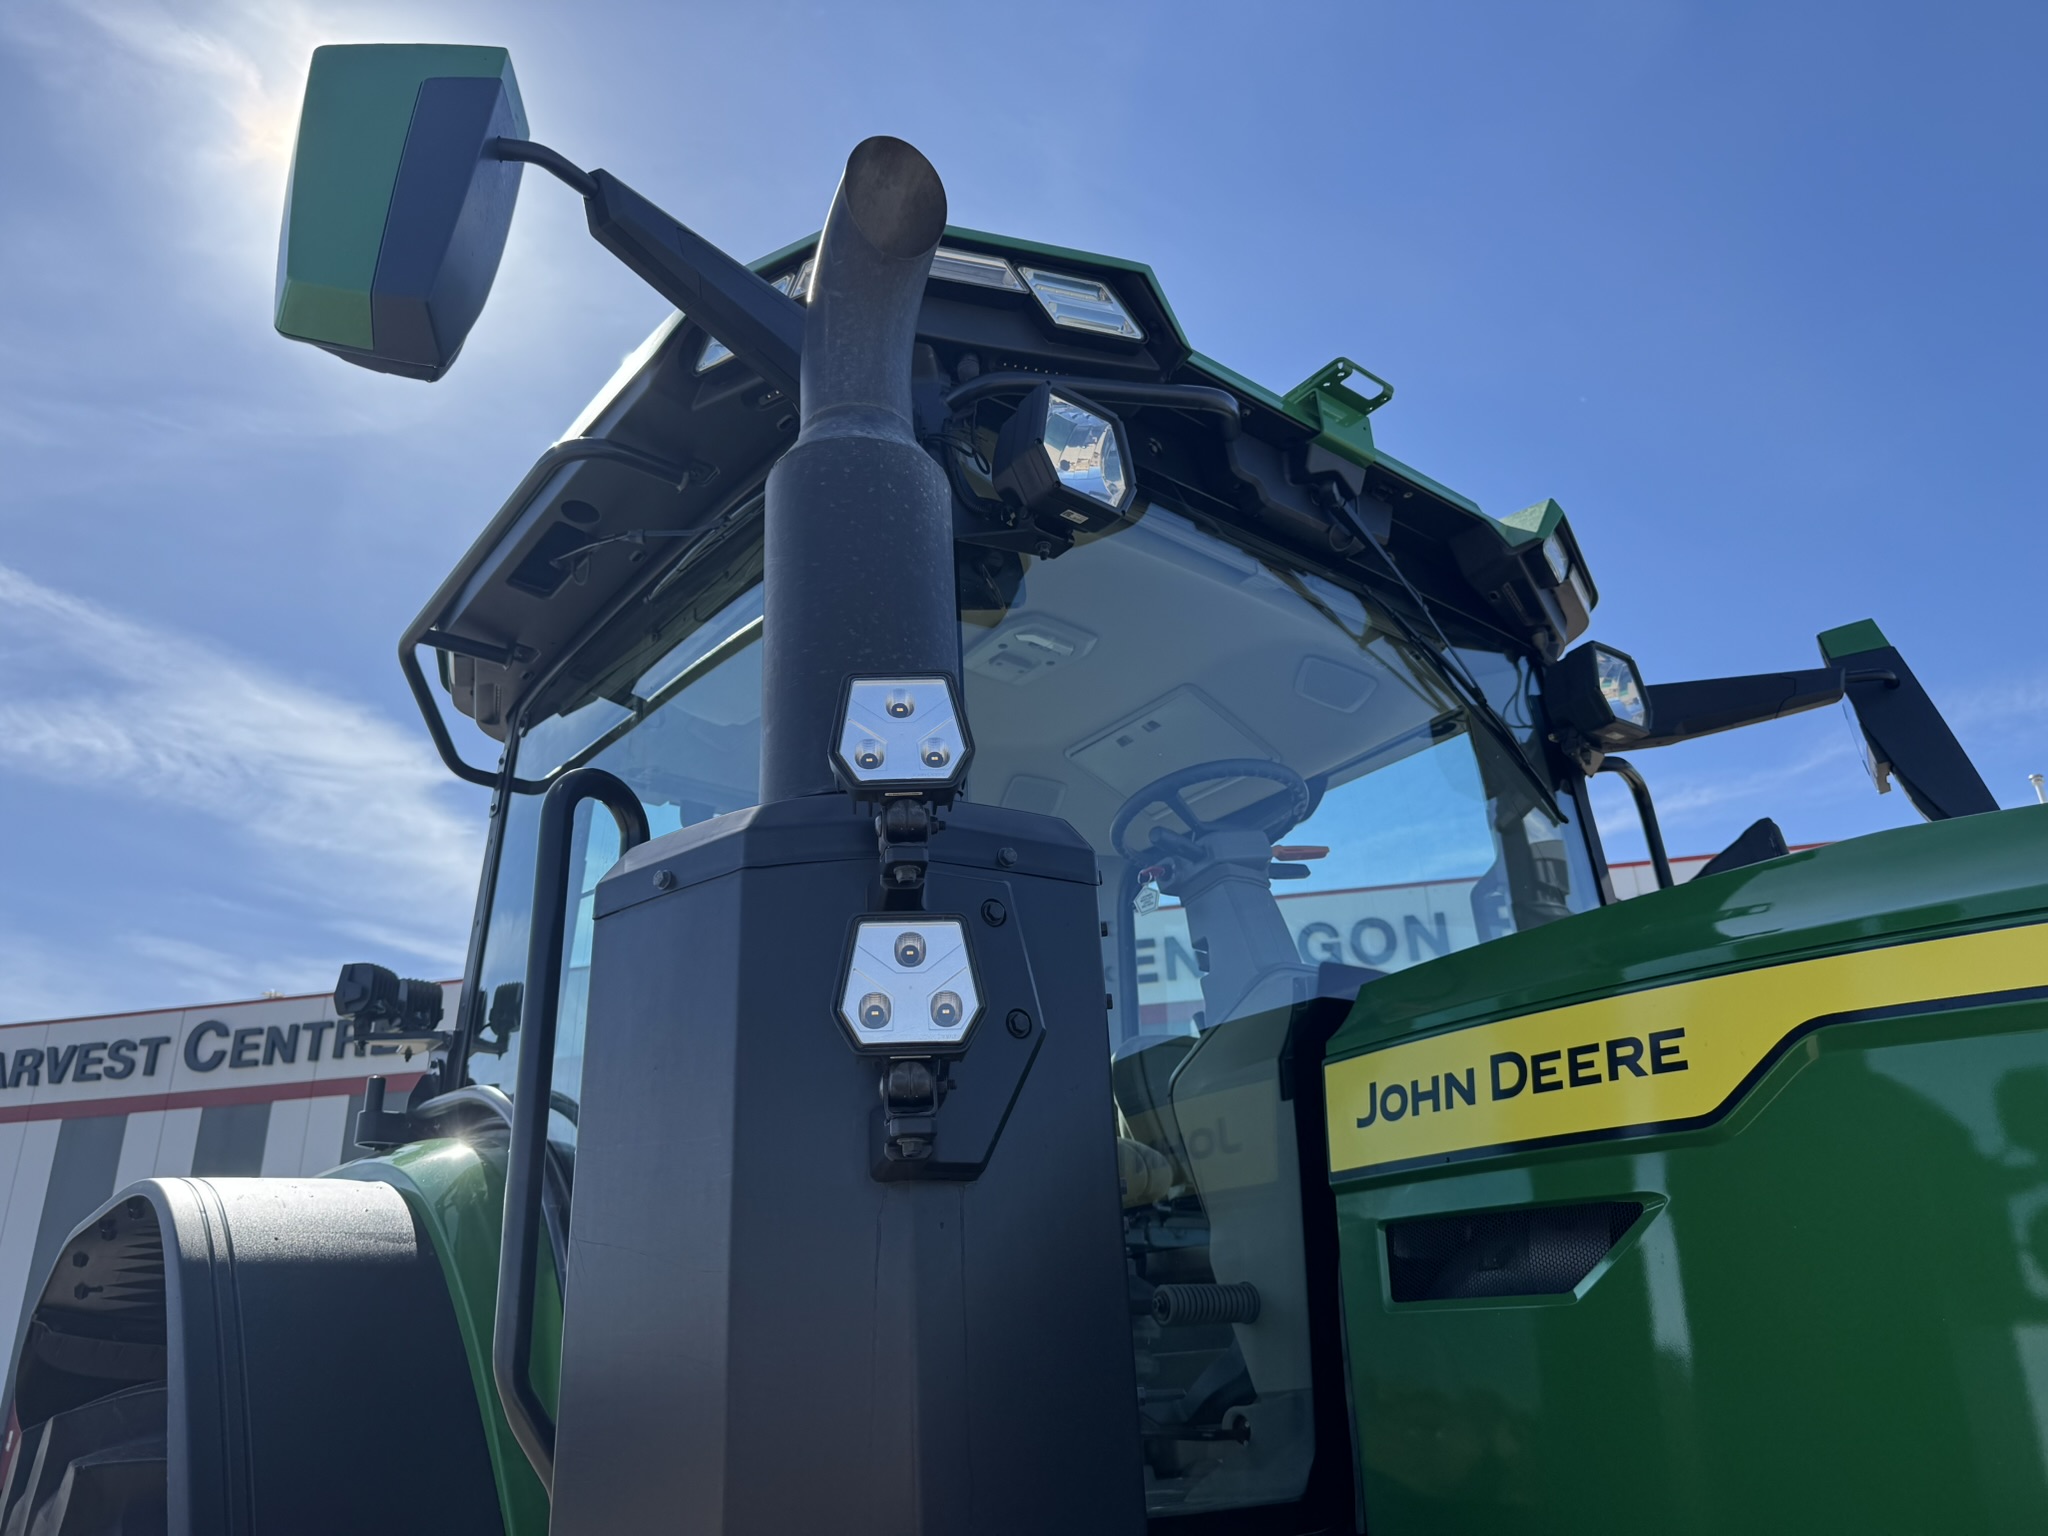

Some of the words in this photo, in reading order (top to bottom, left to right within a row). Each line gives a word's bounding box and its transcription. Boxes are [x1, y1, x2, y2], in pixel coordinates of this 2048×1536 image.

[0, 1036, 171, 1089] RVEST
[1356, 1067, 1477, 1129] JOHN
[1490, 1027, 1690, 1102] DEERE
